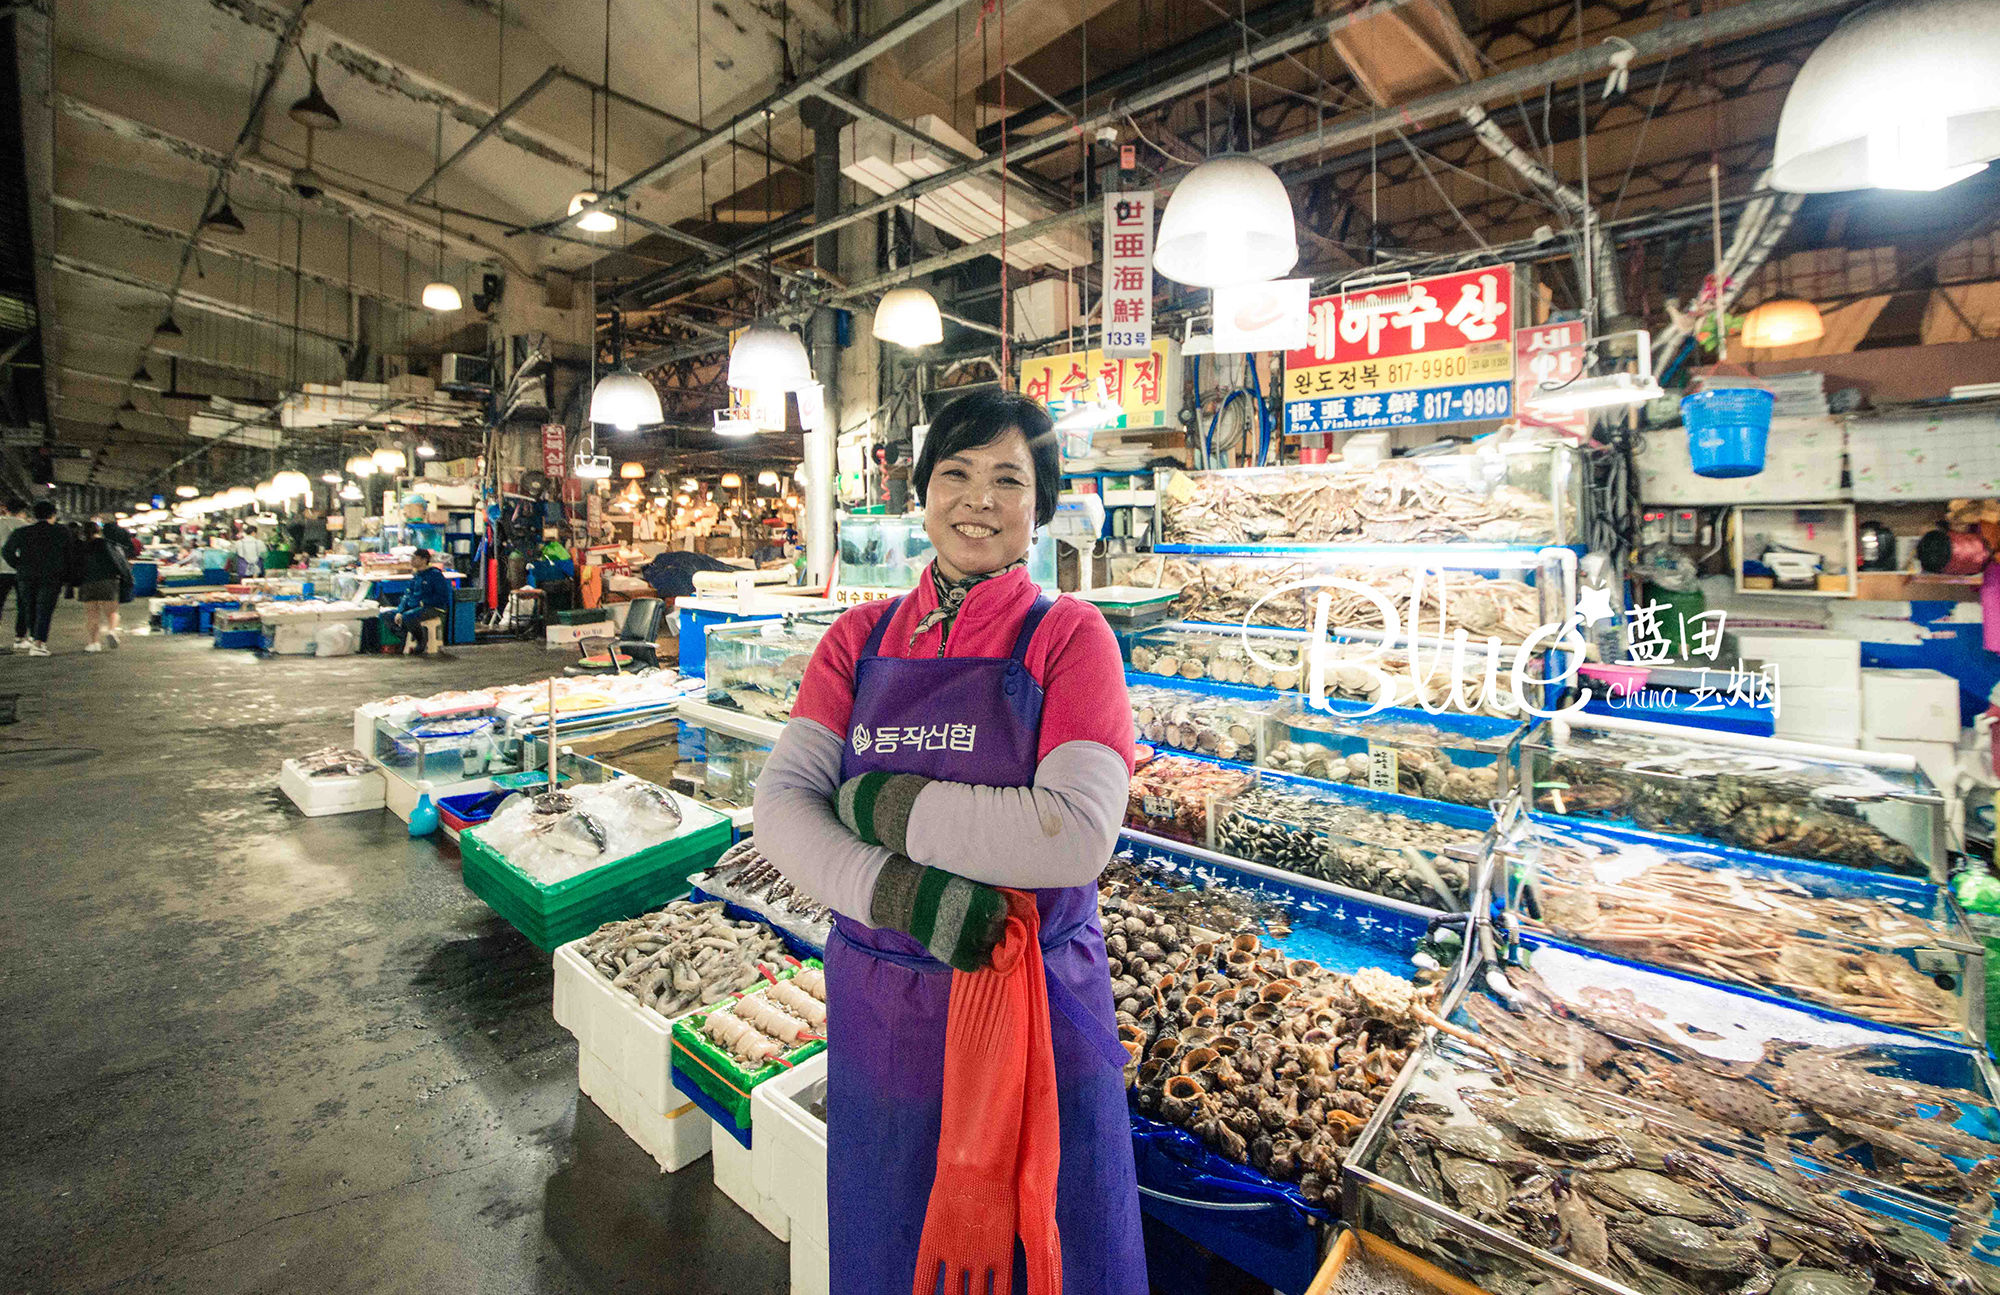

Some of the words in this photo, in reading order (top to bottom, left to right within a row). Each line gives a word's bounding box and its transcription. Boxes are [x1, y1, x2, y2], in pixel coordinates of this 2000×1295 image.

[1026, 352, 1161, 407] 여수회집
[1294, 363, 1380, 395] 완도전복
[1388, 355, 1466, 384] 817-9980
[1424, 386, 1508, 420] 817-9980
[1322, 416, 1389, 430] Fisheries
[1390, 413, 1417, 425] Co.
[875, 723, 977, 754] 동작신협
